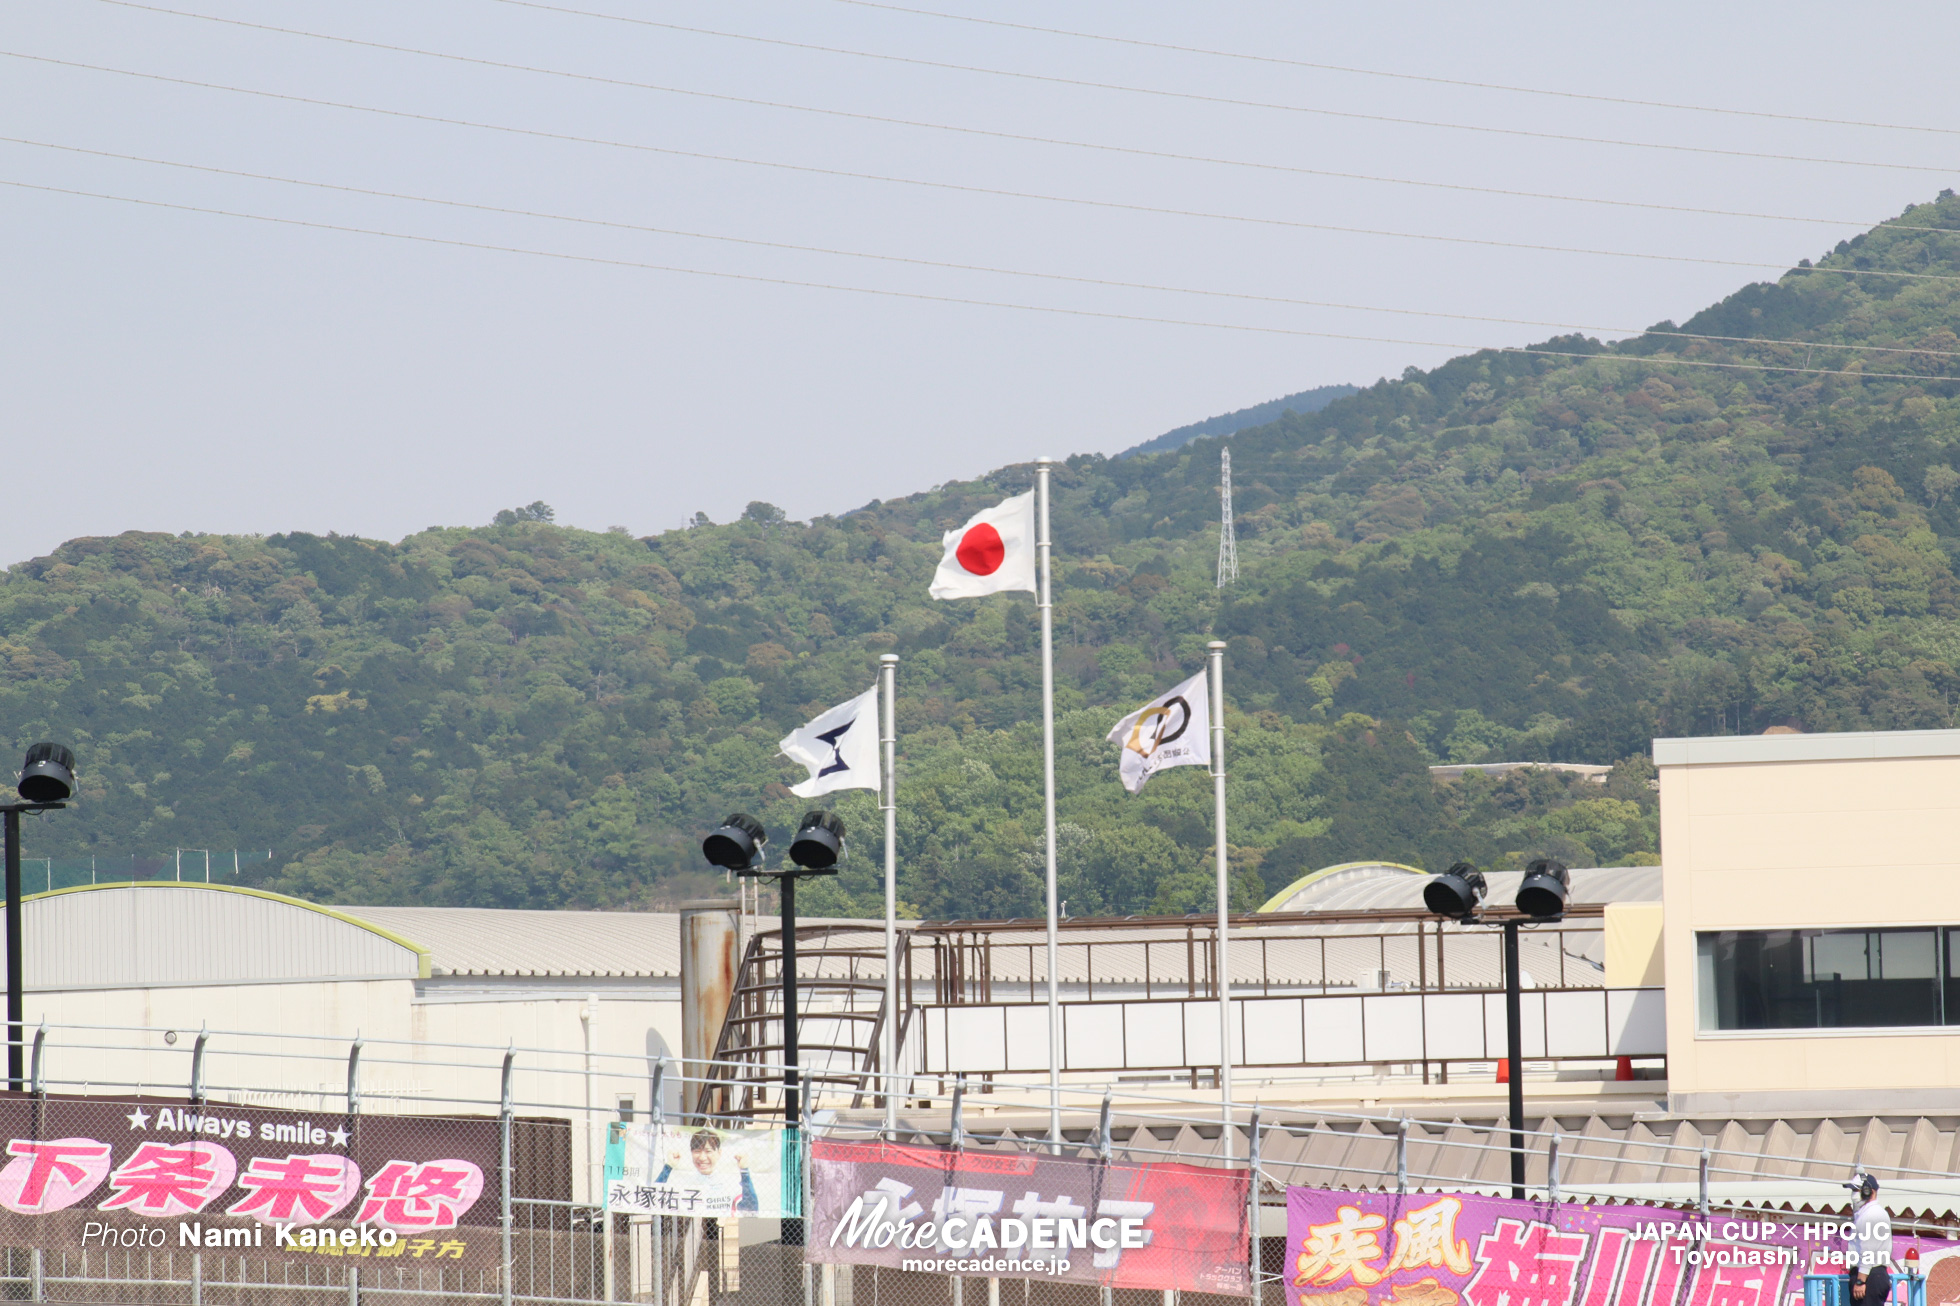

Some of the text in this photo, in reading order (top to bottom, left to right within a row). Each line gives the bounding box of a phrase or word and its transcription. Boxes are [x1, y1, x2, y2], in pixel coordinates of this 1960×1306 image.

[156, 1108, 327, 1146] Always smile
[6, 1138, 467, 1231] 下条未悠
[609, 1184, 703, 1211] 永塚祐子
[1294, 1196, 1473, 1287] 疾風
[1214, 1265, 1242, 1275] アーバン
